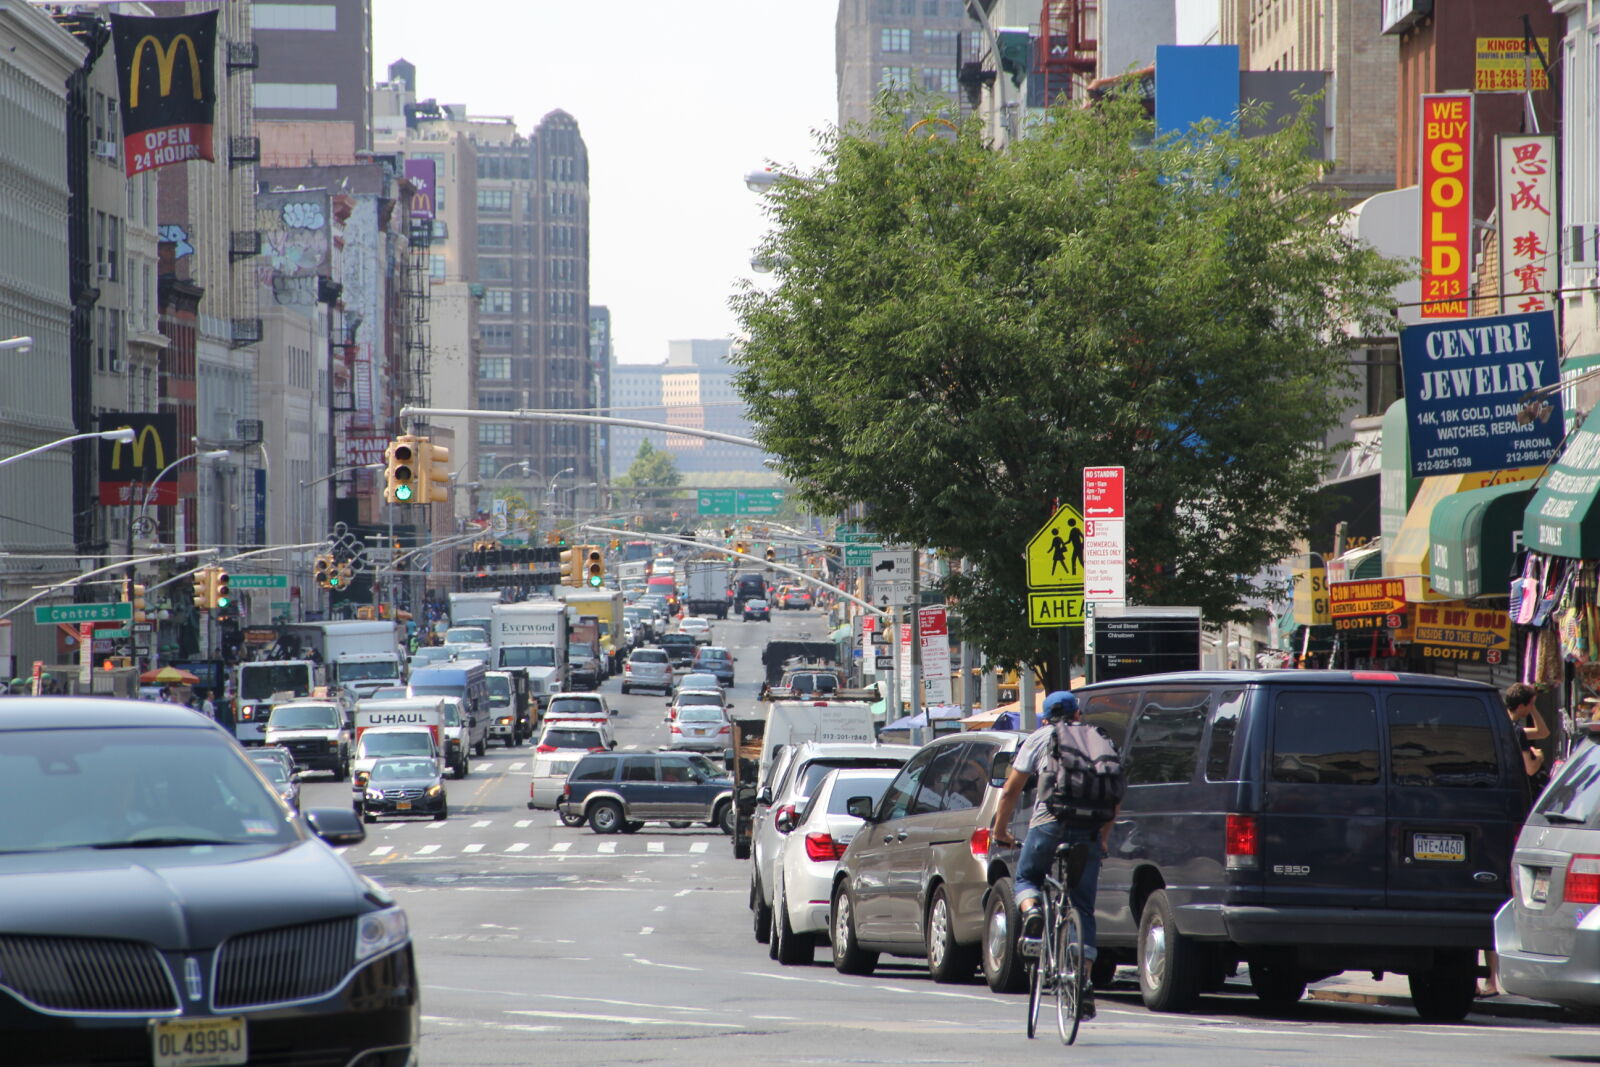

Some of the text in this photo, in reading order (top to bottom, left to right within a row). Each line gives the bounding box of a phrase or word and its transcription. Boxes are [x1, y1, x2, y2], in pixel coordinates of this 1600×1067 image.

[1487, 39, 1537, 51] KINGDO
[1432, 102, 1463, 120] WE
[145, 127, 190, 150] OPEN
[1427, 121, 1468, 140] BUY
[134, 151, 151, 171] 24
[1430, 142, 1464, 276] GOLD
[1429, 280, 1460, 296] 213
[1423, 297, 1467, 314] CANAL
[1425, 321, 1532, 361] CENTRE
[1419, 360, 1545, 400] JEWELRY
[1417, 400, 1550, 426] 14K, 18K GOLD, DIAM
[1437, 420, 1535, 441] WATCHES, REPAIRS
[1427, 437, 1552, 459] LATINO FARONA
[346, 451, 383, 465] PAIN
[1086, 521, 1094, 536] 3
[1086, 540, 1119, 548] COMMERCIAL
[50, 607, 116, 620] Centre St
[1335, 617, 1373, 631] BOOTH
[1386, 614, 1402, 629] 3
[1419, 608, 1507, 630] WE BUY GOLD
[501, 622, 555, 632] Everwood
[1417, 627, 1496, 645] INSIDE TO THE RIGHT
[1423, 645, 1502, 665] BOOTH # 3
[369, 713, 427, 724] U-HAUL
[1273, 865, 1310, 873] E350
